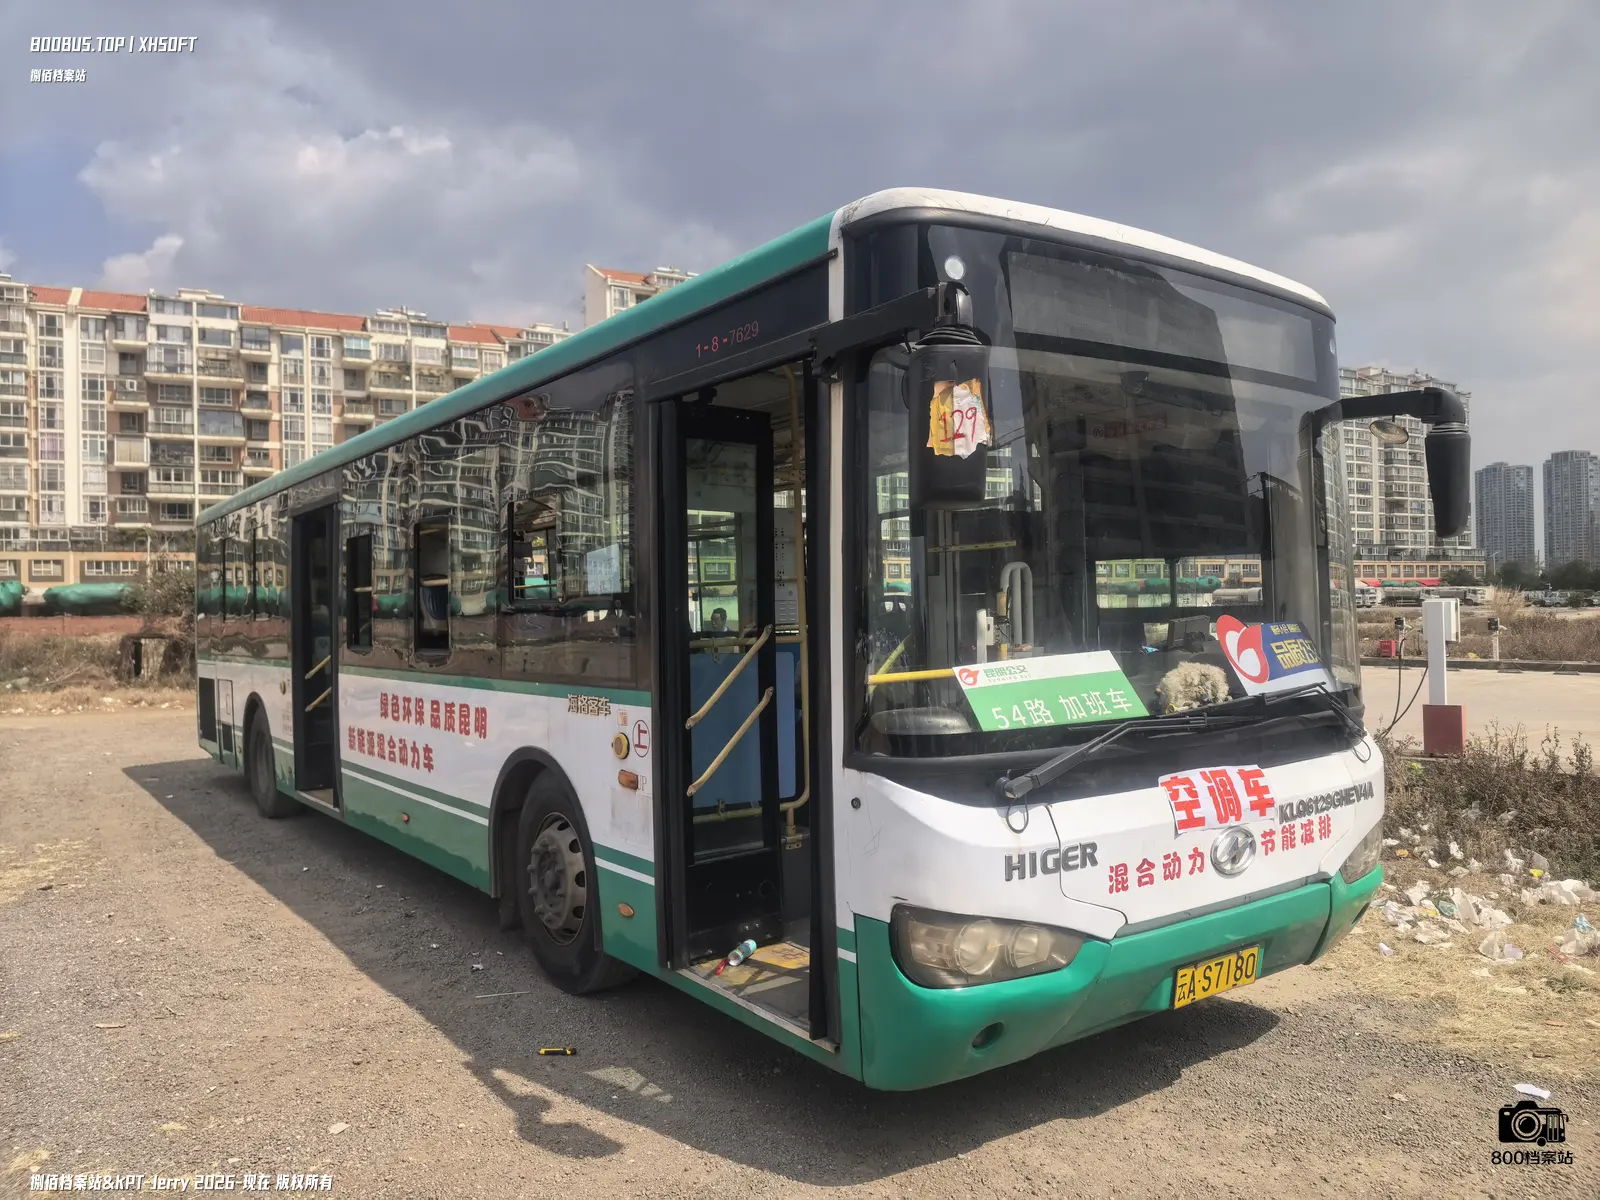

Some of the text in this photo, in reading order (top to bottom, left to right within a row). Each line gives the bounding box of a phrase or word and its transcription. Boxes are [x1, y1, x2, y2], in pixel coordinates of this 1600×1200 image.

[938, 406, 977, 443] 129
[983, 664, 1028, 678] 昆明公交
[379, 692, 488, 739] 绿色环保 品质昆明
[567, 693, 612, 717] 海格客车
[991, 688, 1133, 729] 54路 加班车
[348, 725, 435, 774] 新能源混合动力车
[634, 723, 648, 750] 上
[1160, 768, 1275, 831] 空调车
[1279, 780, 1376, 825] KLQ6129GHEV4A
[1004, 842, 1099, 882] HIGER
[1108, 814, 1332, 895] 混合动力 节能减排
